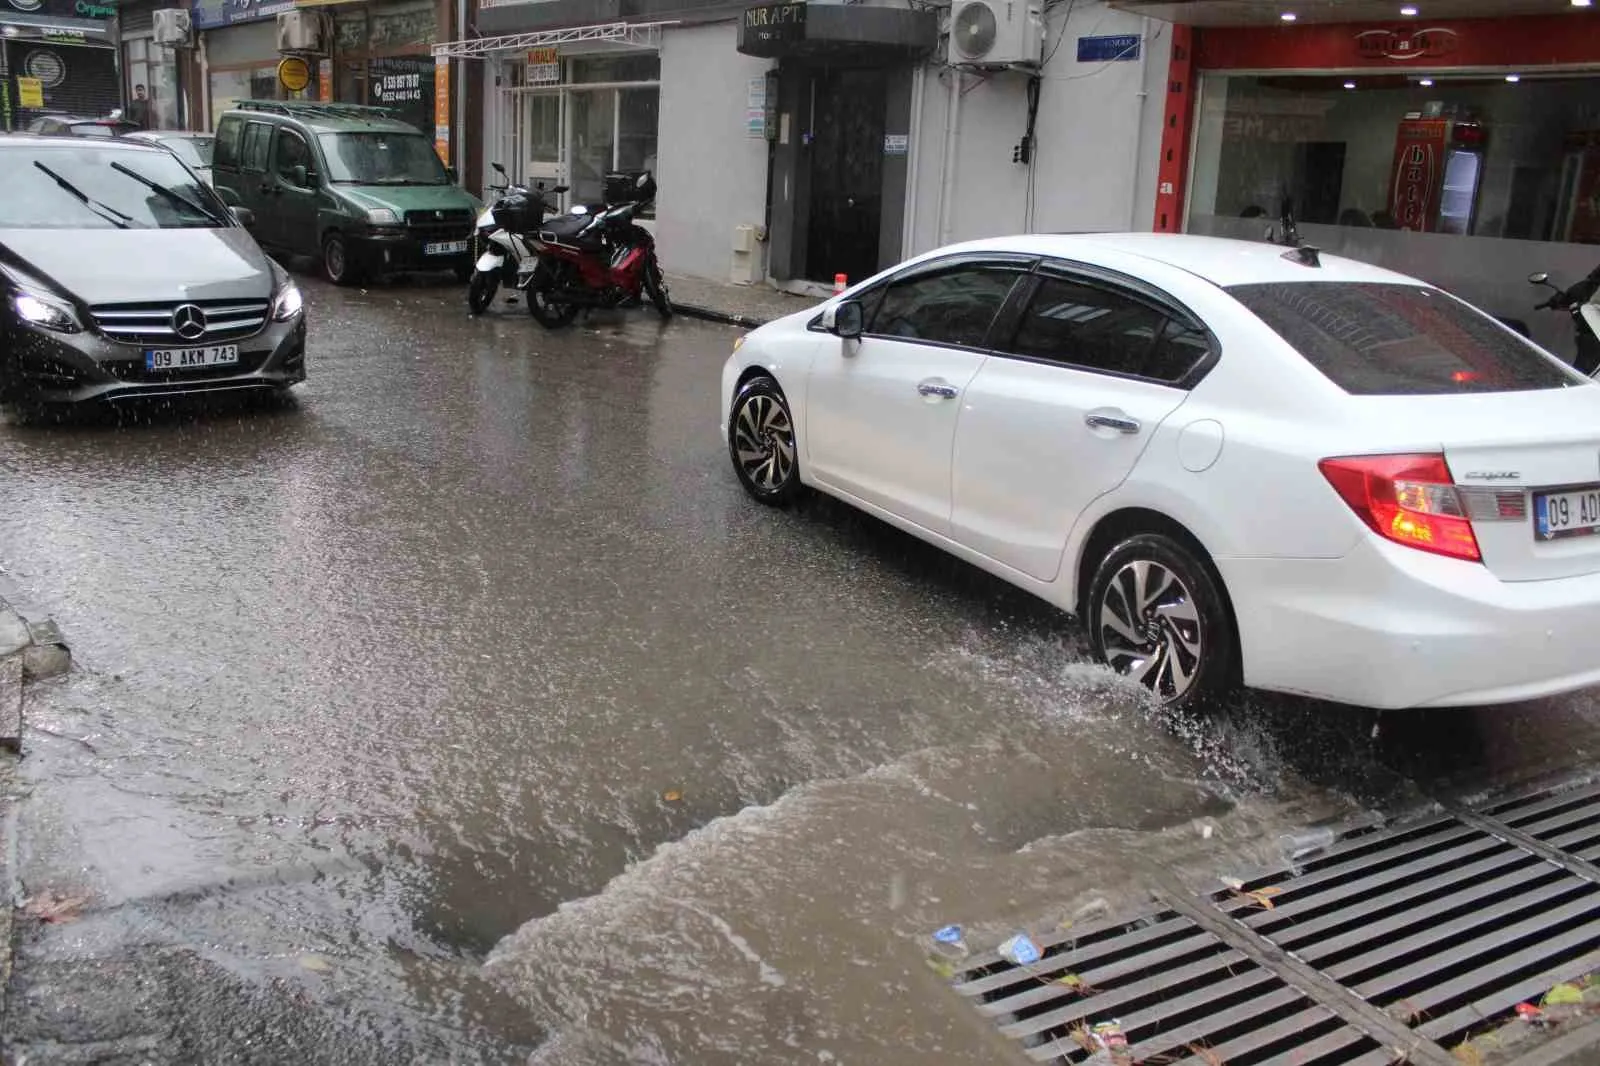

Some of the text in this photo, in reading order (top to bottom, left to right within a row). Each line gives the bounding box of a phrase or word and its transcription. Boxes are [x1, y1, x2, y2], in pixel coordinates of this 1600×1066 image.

[746, 5, 802, 27] NUR APT.
[154, 352, 172, 367] 09
[211, 347, 236, 363] 743
[1549, 492, 1600, 527] 09 AD
